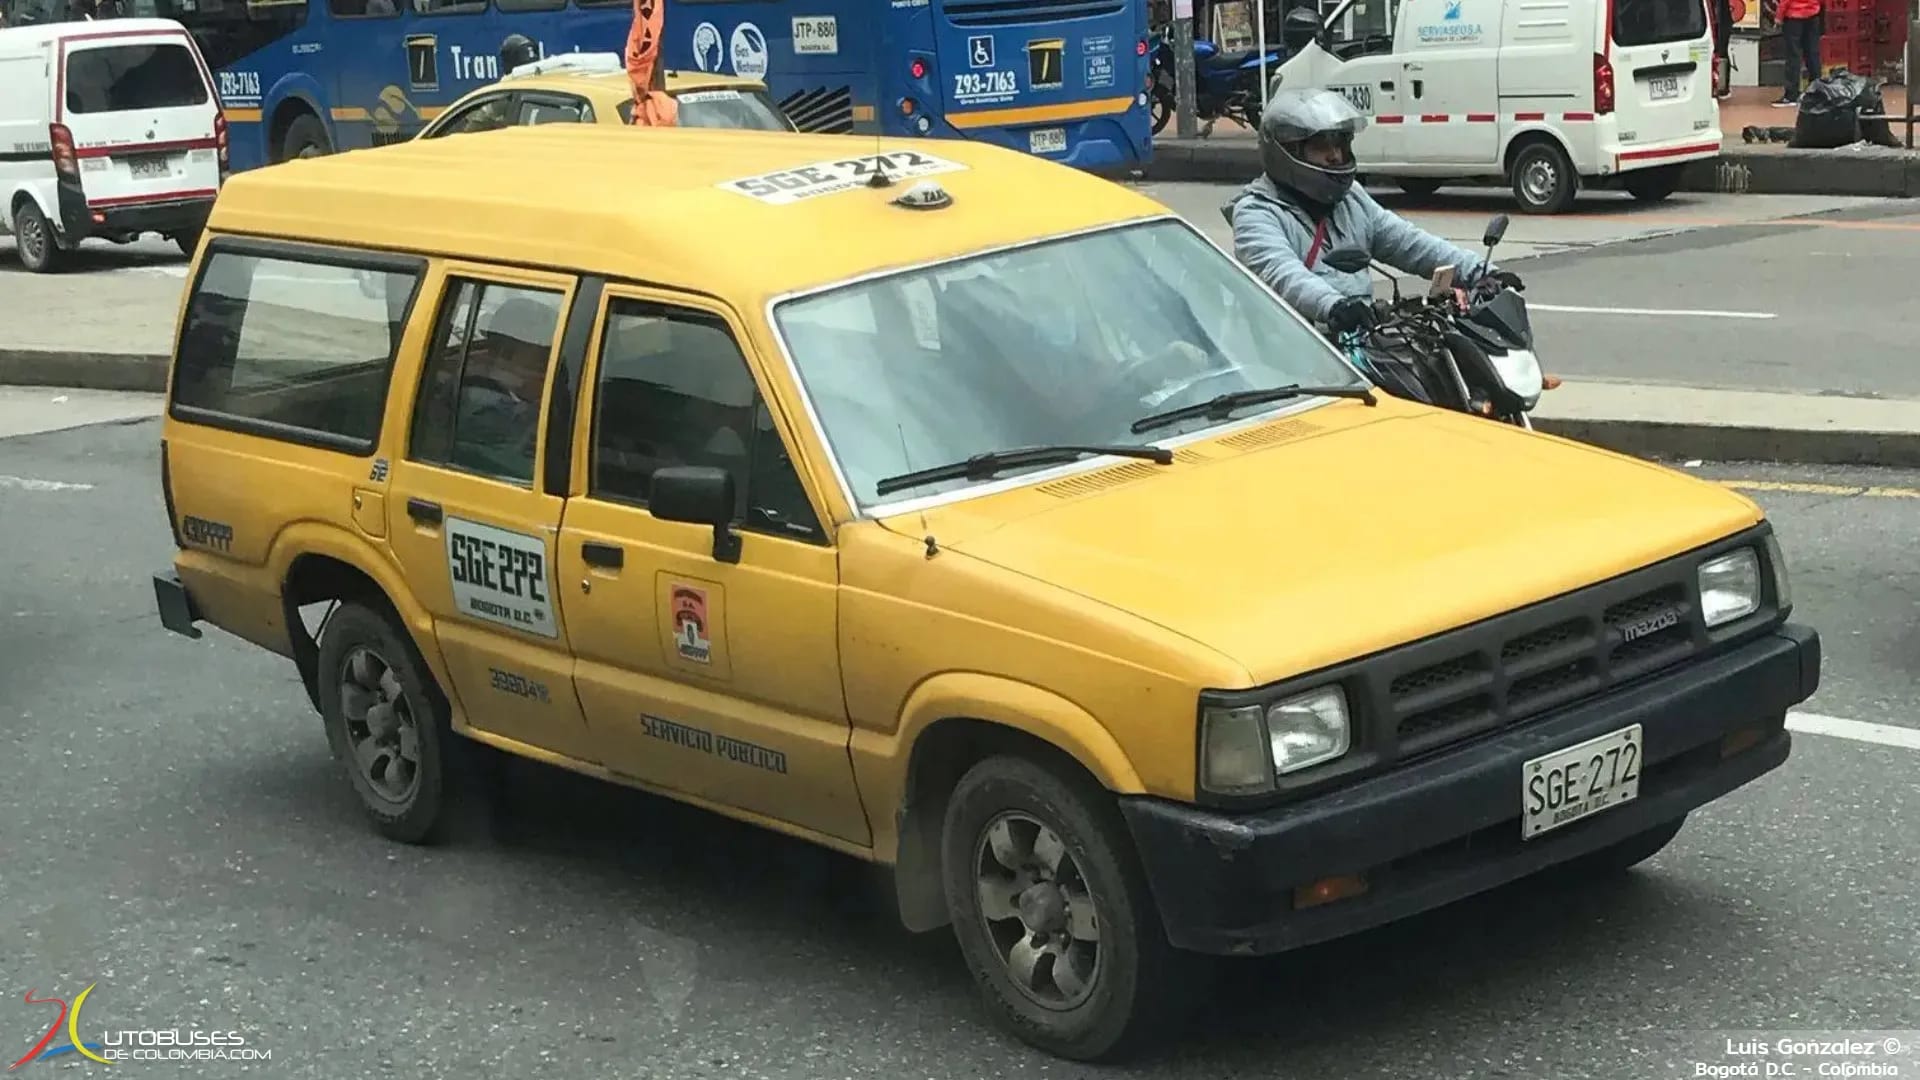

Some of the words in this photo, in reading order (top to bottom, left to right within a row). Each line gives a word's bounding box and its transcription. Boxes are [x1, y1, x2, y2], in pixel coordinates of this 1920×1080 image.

[735, 44, 750, 57] Gas
[954, 71, 1016, 95] Z93-7163
[735, 168, 838, 197] SGE
[834, 151, 934, 176] 272
[640, 713, 713, 755] SERVICIO
[716, 734, 788, 775] PUBLICO
